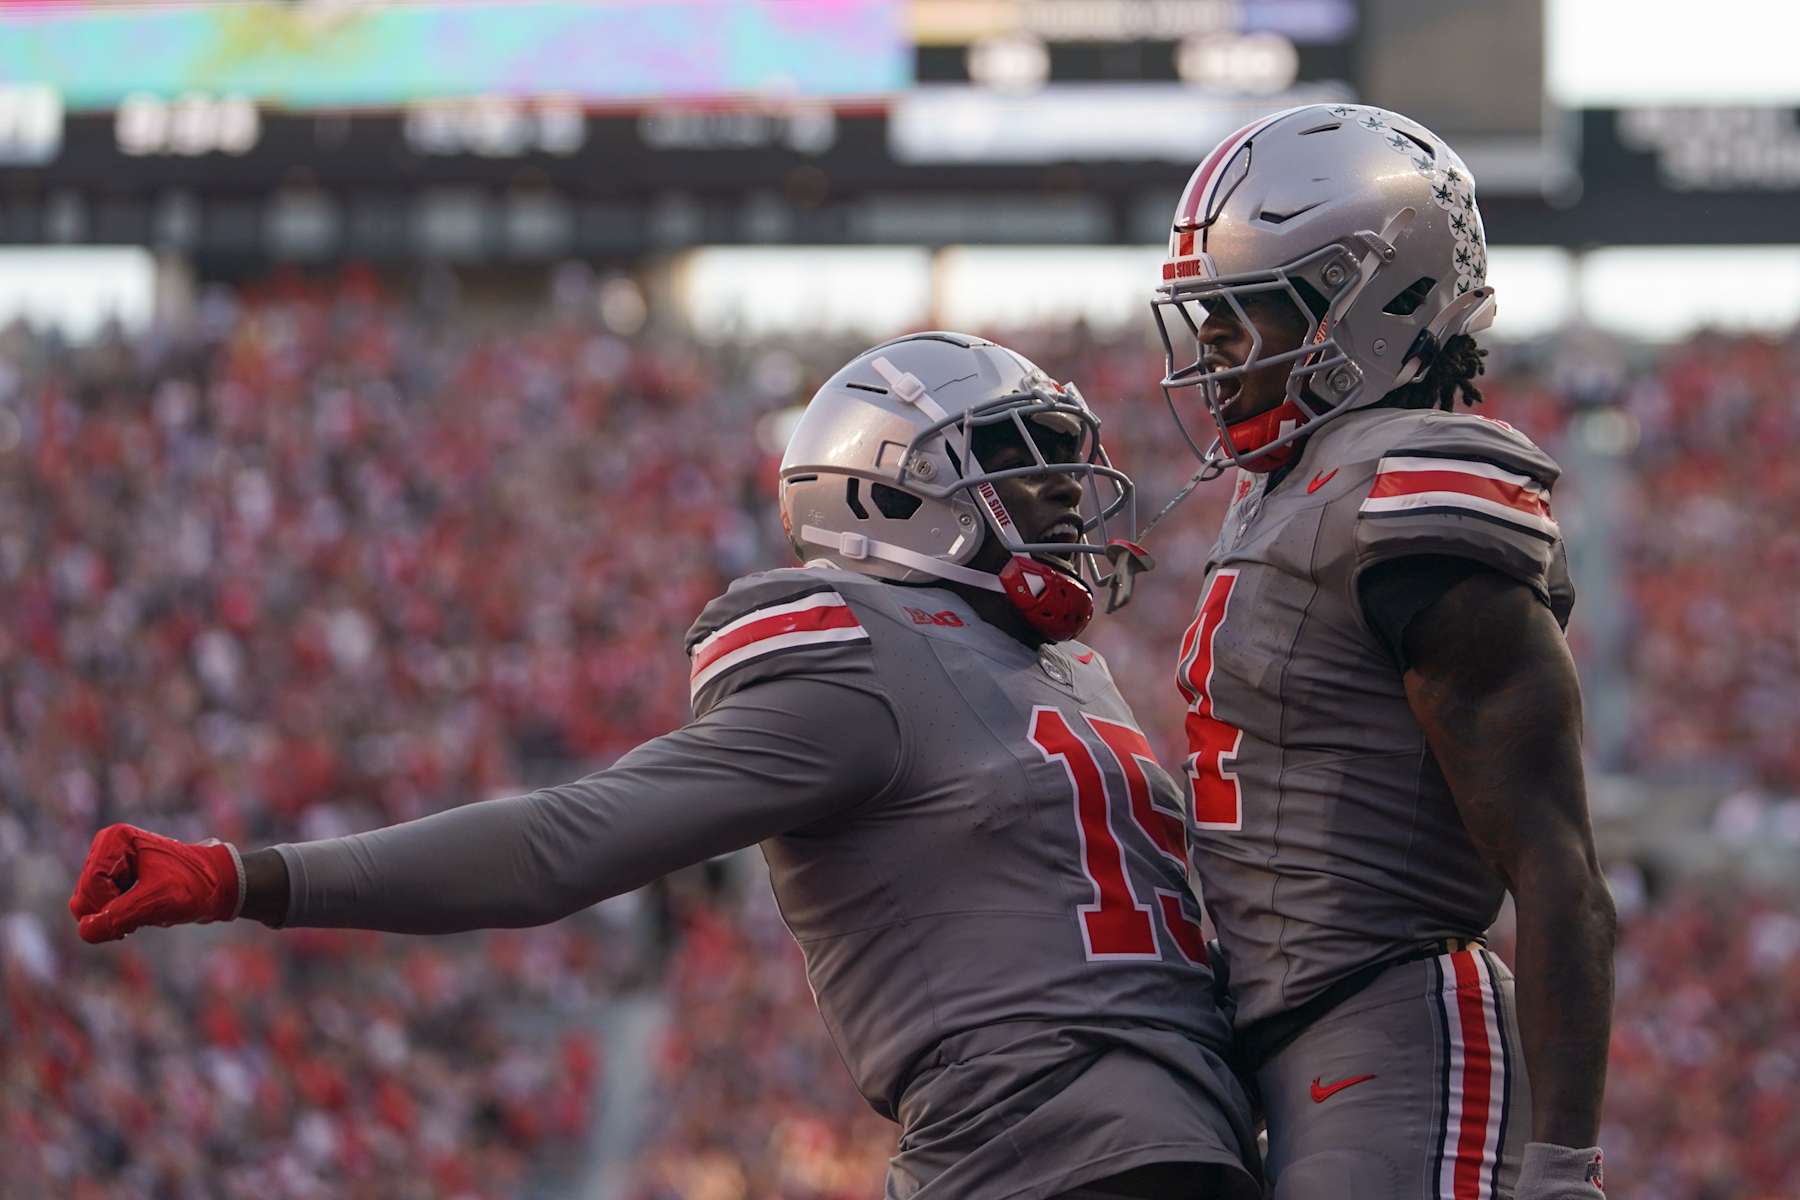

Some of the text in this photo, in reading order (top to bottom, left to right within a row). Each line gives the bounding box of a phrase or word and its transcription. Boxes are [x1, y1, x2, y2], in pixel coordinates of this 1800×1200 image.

[1177, 259, 1201, 278] STATE
[989, 499, 1011, 526] STATE
[1174, 568, 1244, 832] 4
[1026, 704, 1213, 977] 15
